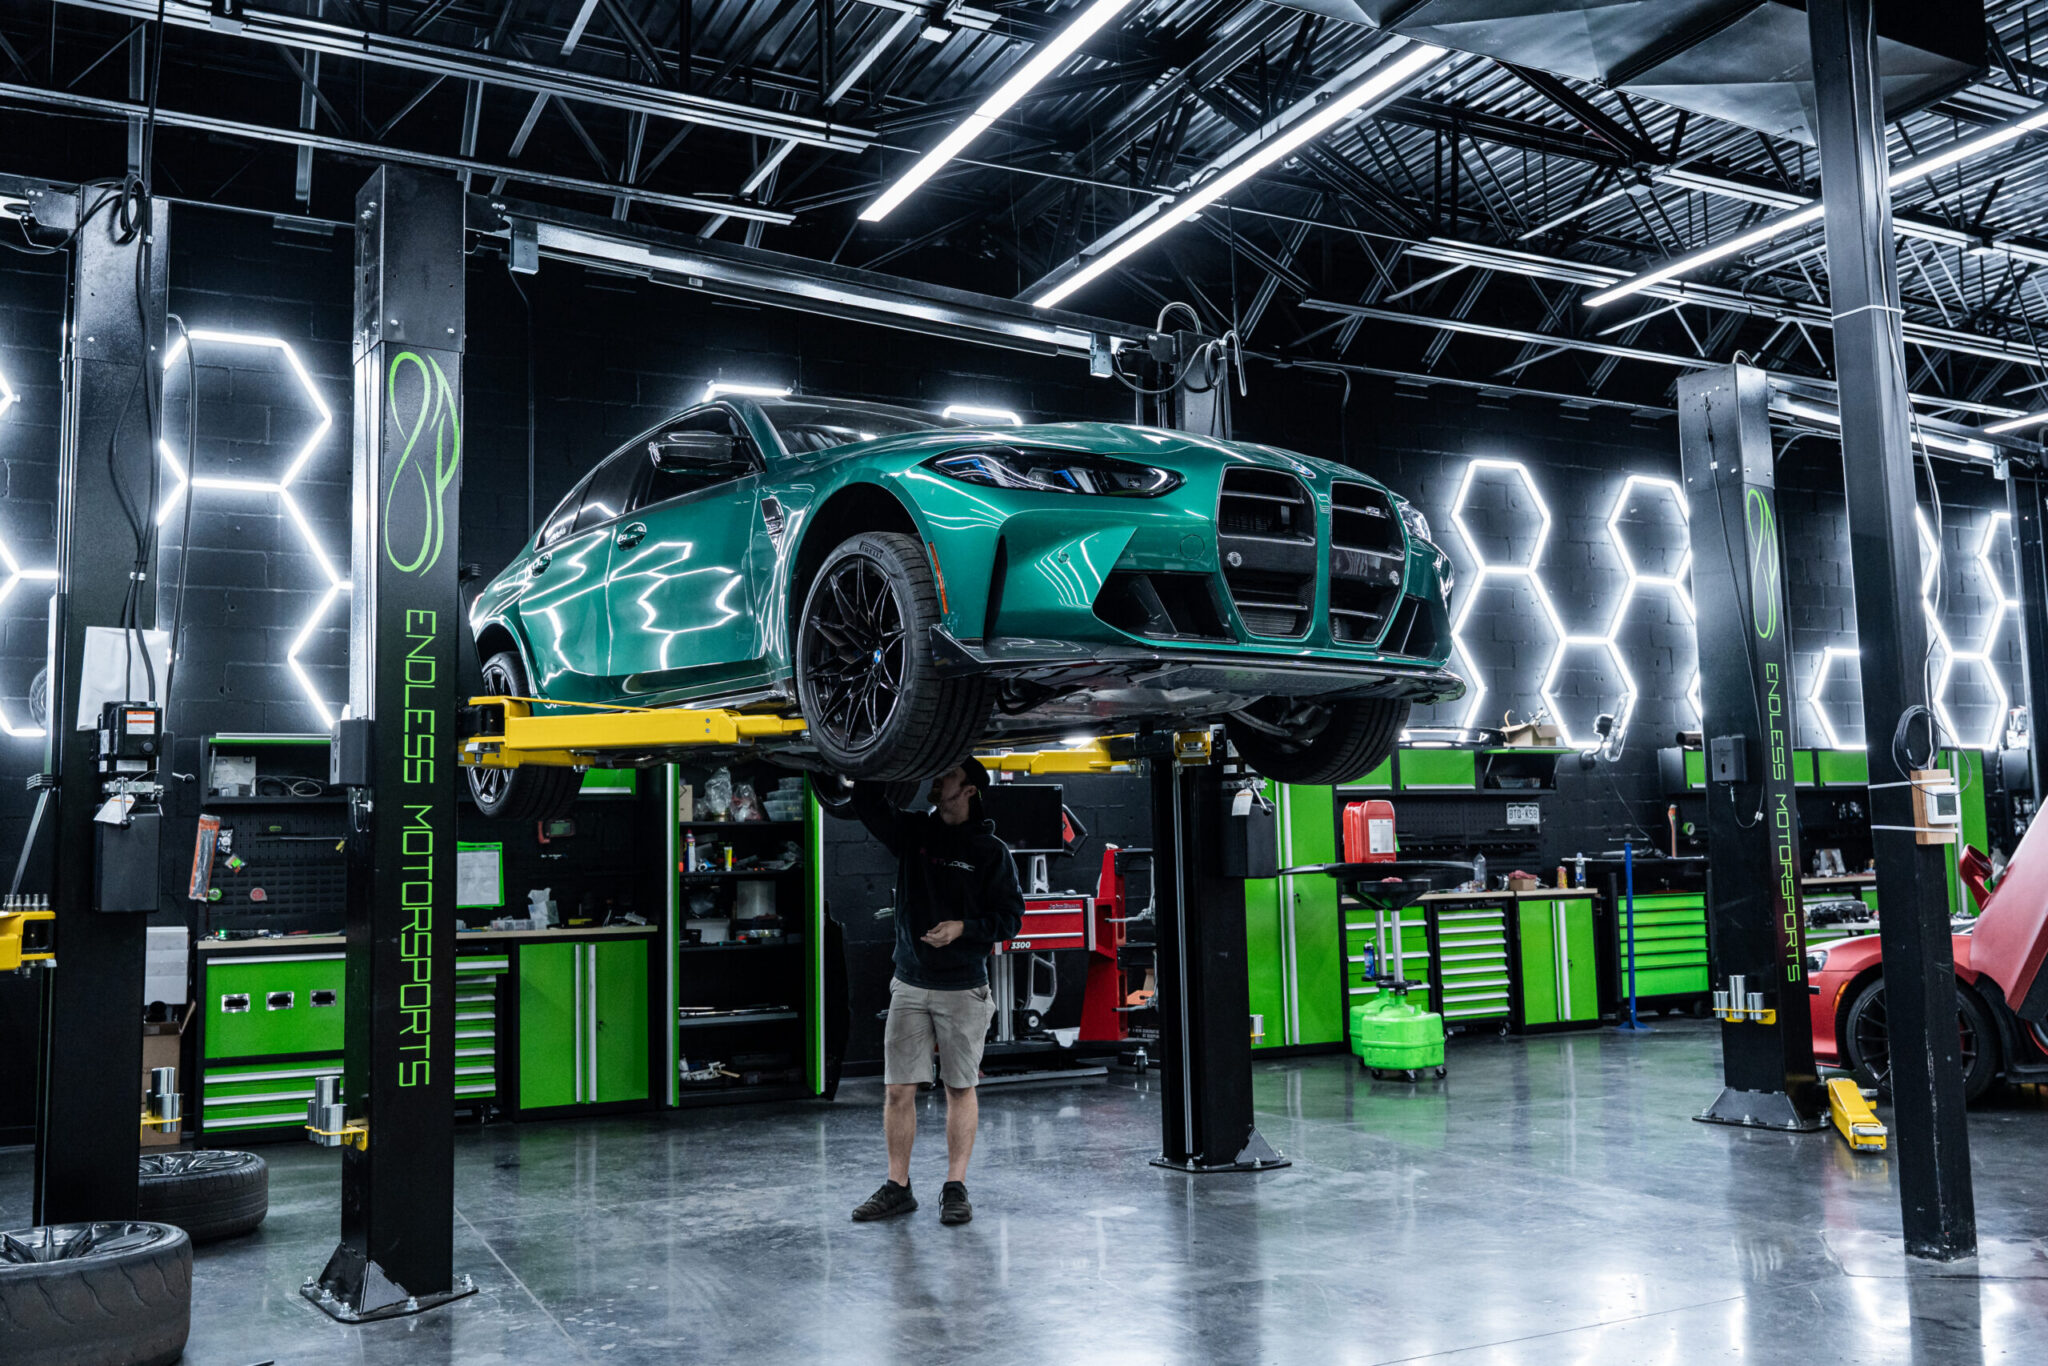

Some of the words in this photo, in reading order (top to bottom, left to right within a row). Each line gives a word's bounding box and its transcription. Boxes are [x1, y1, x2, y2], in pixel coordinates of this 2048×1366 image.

[403, 609, 436, 784] ENDLESS
[1766, 663, 1786, 781] ENDLESS
[399, 804, 434, 1087] MOTORSPORTS
[1775, 793, 1801, 982] MOTORSPORTS
